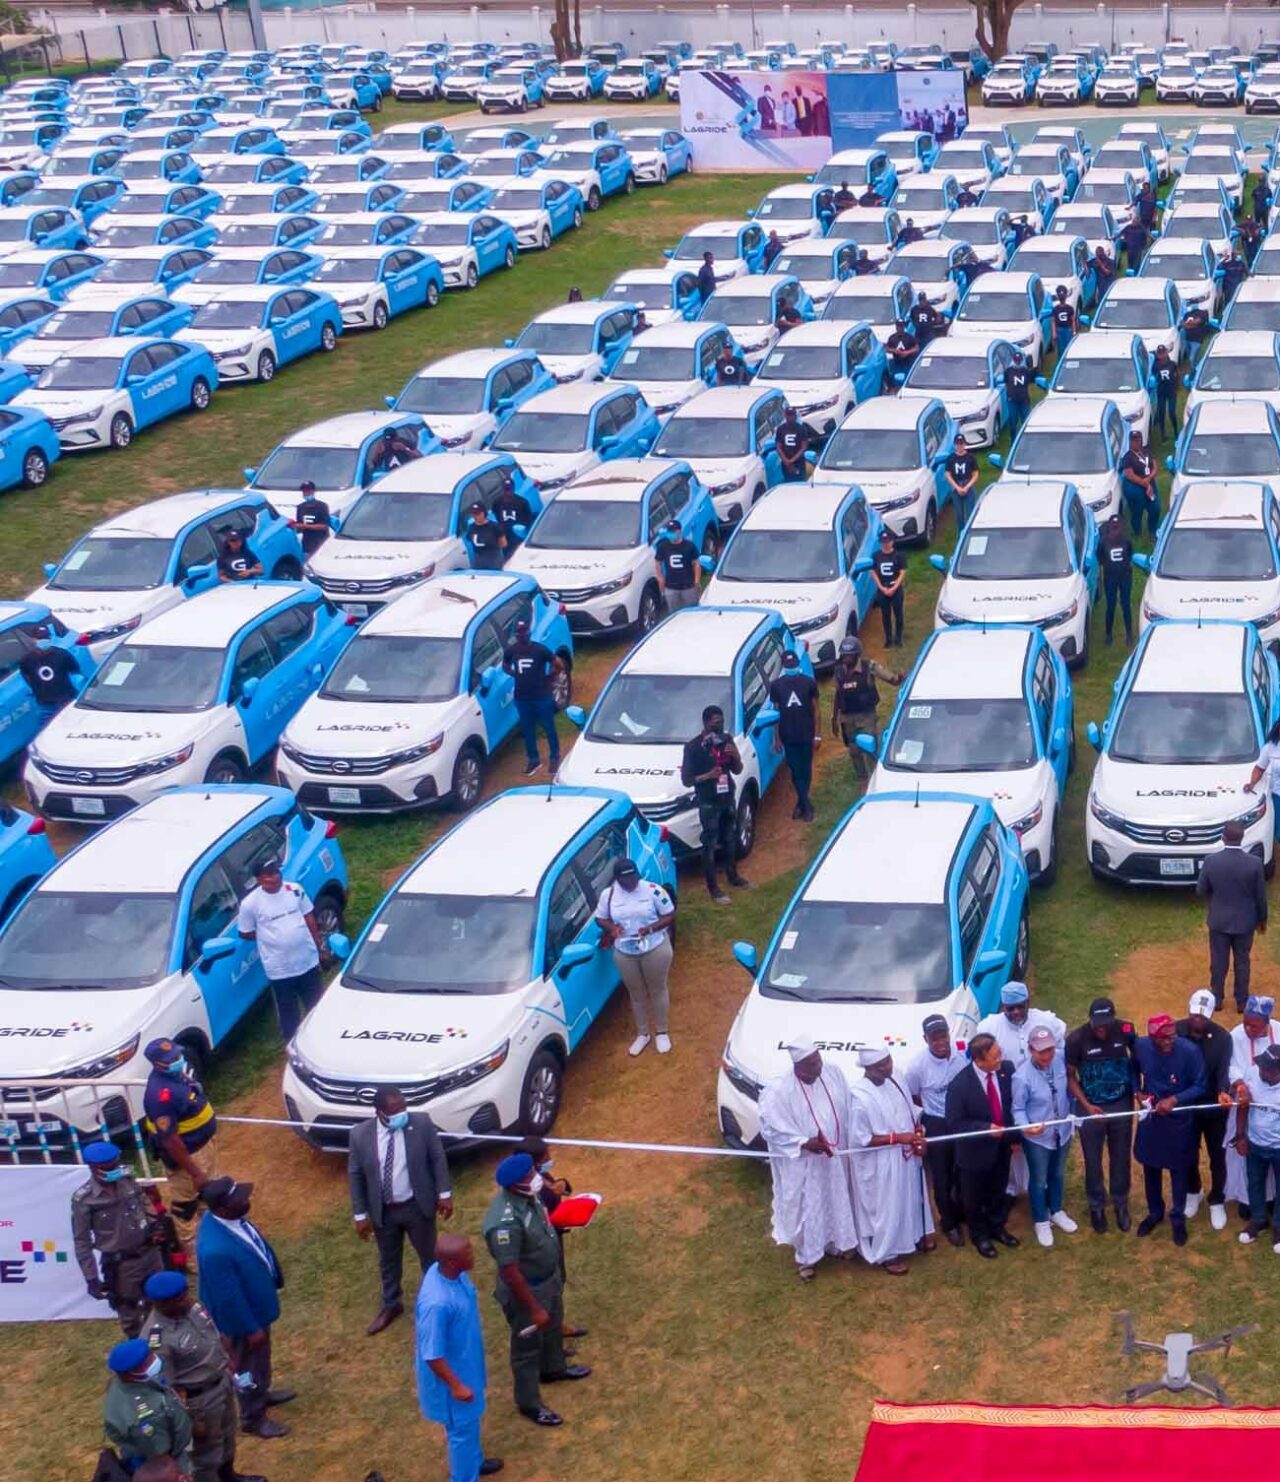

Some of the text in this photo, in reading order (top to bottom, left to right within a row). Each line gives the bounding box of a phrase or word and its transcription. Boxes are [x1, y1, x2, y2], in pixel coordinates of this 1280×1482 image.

[919, 313, 928, 322] R
[1058, 312, 1068, 321] G
[724, 365, 735, 375] O
[1160, 369, 1170, 380] R
[1014, 375, 1025, 385] N
[785, 434, 797, 446] E
[389, 456, 400, 466] A
[955, 463, 966, 474] M
[473, 534, 485, 546] L
[1110, 548, 1123, 561] E
[231, 559, 247, 571] G
[669, 554, 683, 567] E
[880, 562, 893, 576] E
[518, 658, 534, 673] F
[38, 666, 54, 681] O
[787, 691, 802, 707] A
[315, 724, 393, 732] LAGRIDE
[65, 733, 141, 741] LAGRIDE
[594, 767, 676, 776] LAGRIDE
[1136, 790, 1218, 798] LAGRIDE
[339, 1030, 443, 1043] LAGRIDE
